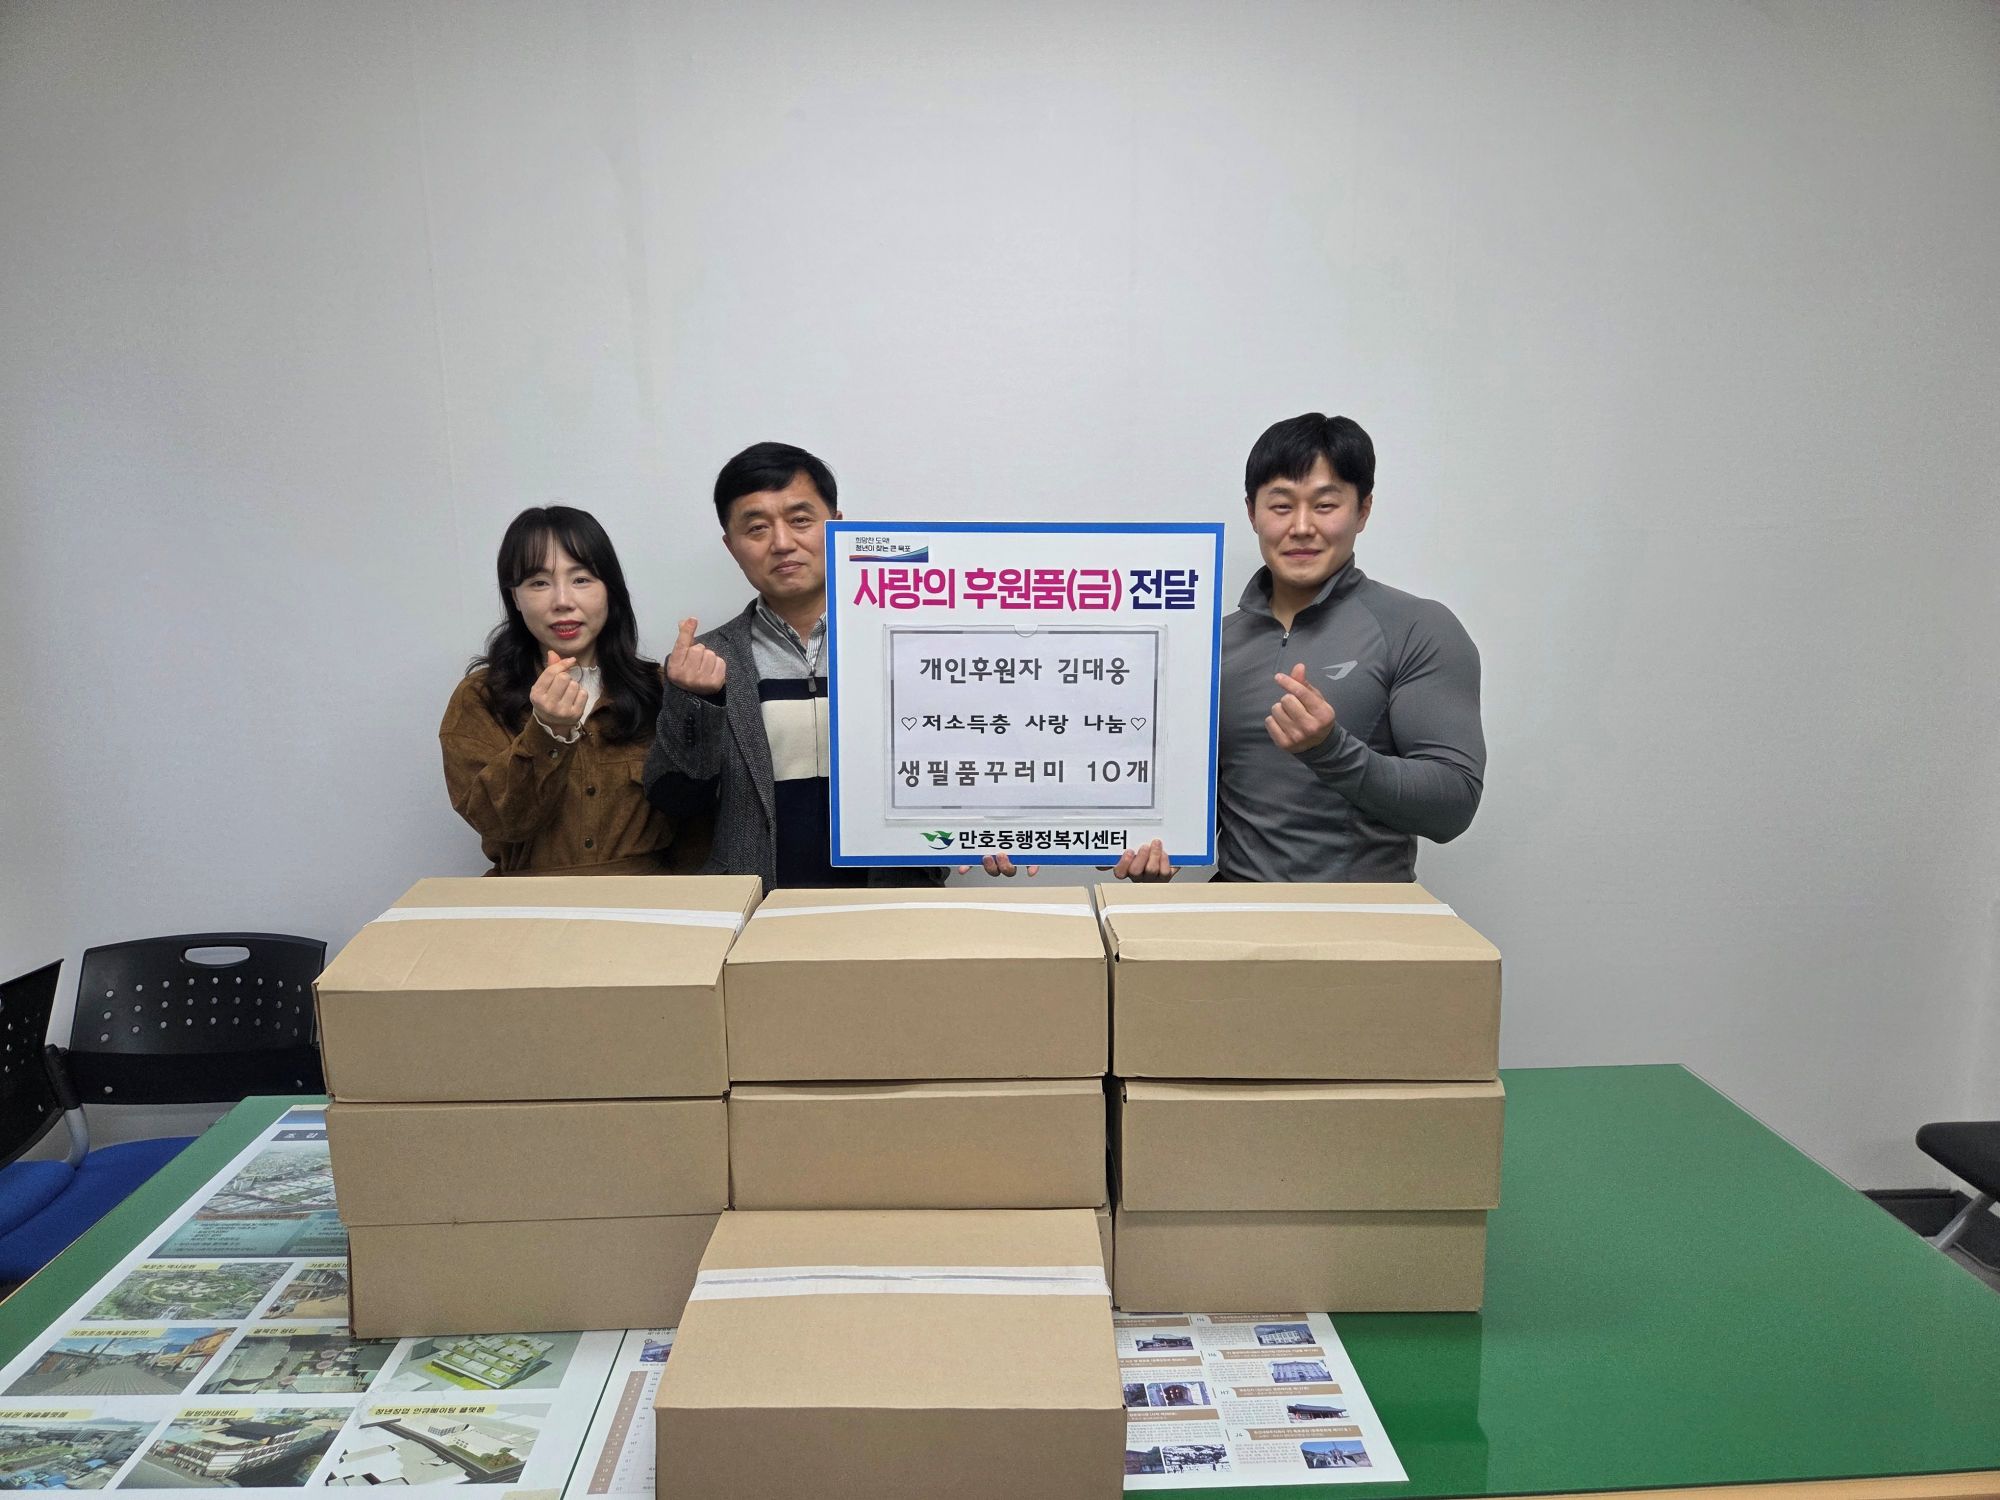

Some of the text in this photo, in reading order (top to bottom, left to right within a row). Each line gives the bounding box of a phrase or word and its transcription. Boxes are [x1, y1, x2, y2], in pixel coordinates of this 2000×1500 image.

[855, 544, 911, 552] 청년이 찾는 큰 목포
[853, 567, 1199, 611] 사랑의 후원품(금) 전달
[919, 656, 1130, 686] 개인후원자 김대웅
[921, 713, 1127, 735] 저소득층 사랑 나눔
[897, 759, 1149, 787] 생필품꾸러미 10개
[958, 829, 1128, 851] 만호동행정복지센터
